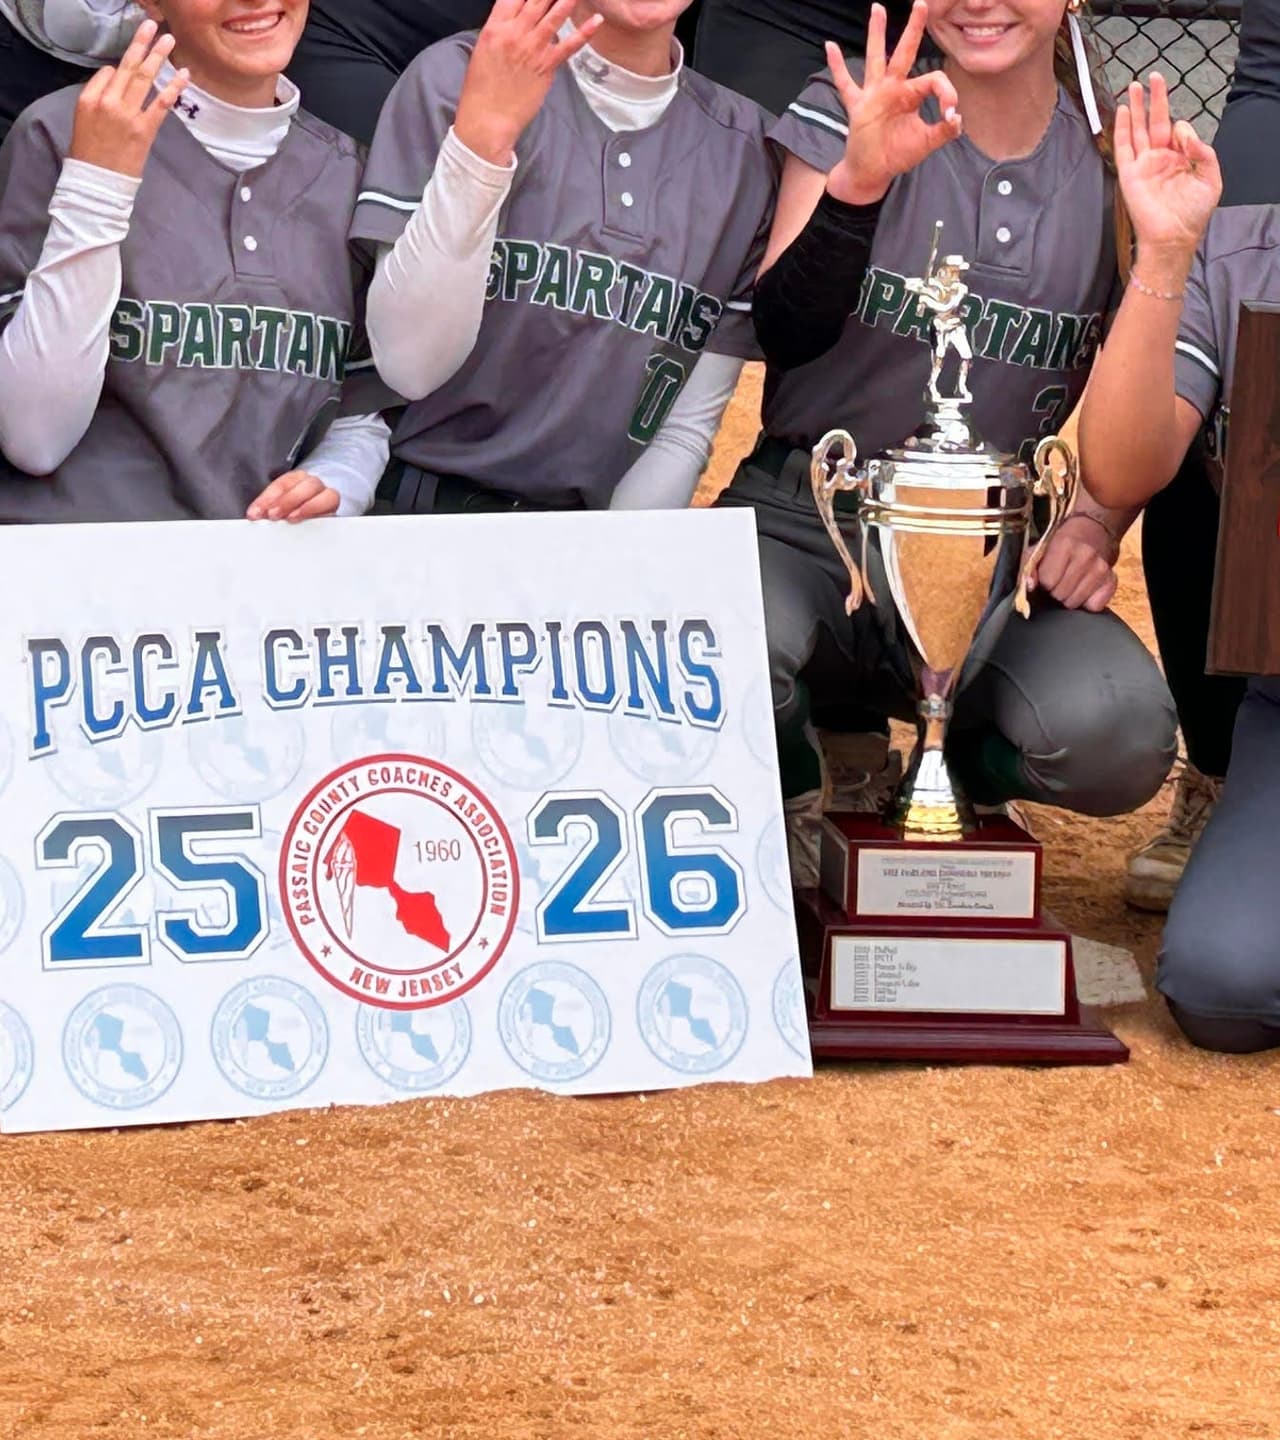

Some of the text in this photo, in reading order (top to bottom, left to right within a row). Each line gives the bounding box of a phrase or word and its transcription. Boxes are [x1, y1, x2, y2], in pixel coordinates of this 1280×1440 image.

[27, 618, 727, 756] PCCA CHAMPIONS
[36, 785, 748, 970] 25 26
[292, 766, 508, 926] PASSAIC COUNTY COACHES ASSOCIATION
[414, 838, 462, 863] 1960
[349, 962, 465, 998] NEW JERSEY
